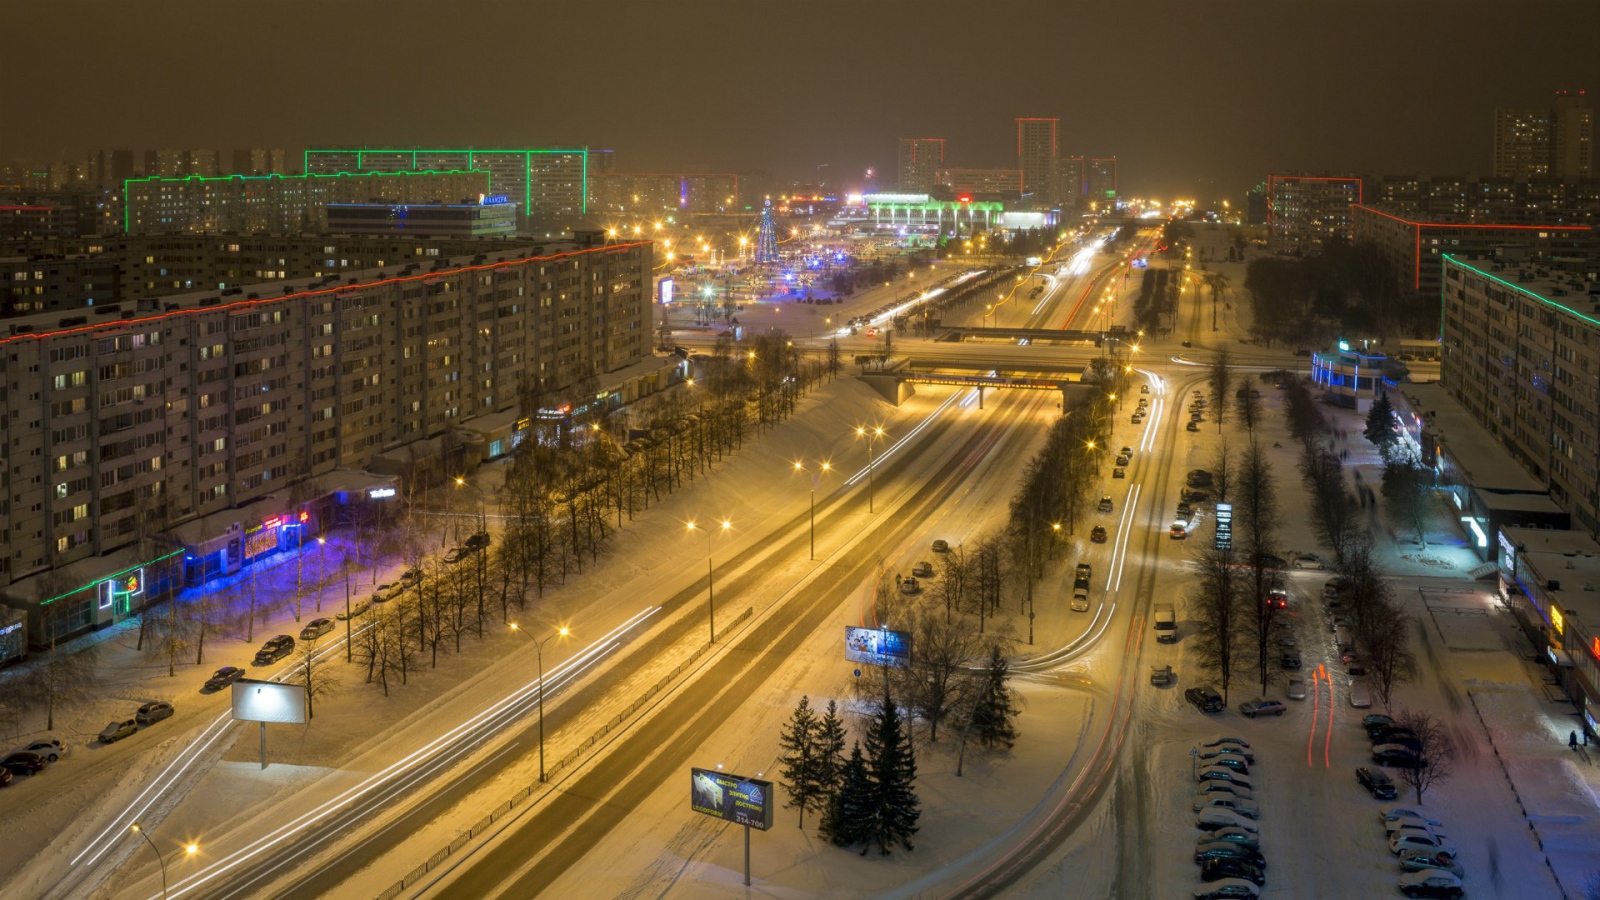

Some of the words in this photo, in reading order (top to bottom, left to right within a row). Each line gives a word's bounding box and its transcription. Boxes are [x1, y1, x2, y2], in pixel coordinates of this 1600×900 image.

[716, 779, 738, 789] БЫСТРО
[728, 790, 749, 800] ЭЛИТНО
[735, 800, 763, 812] ДОСТУПНО
[736, 816, 763, 828] 314-700
